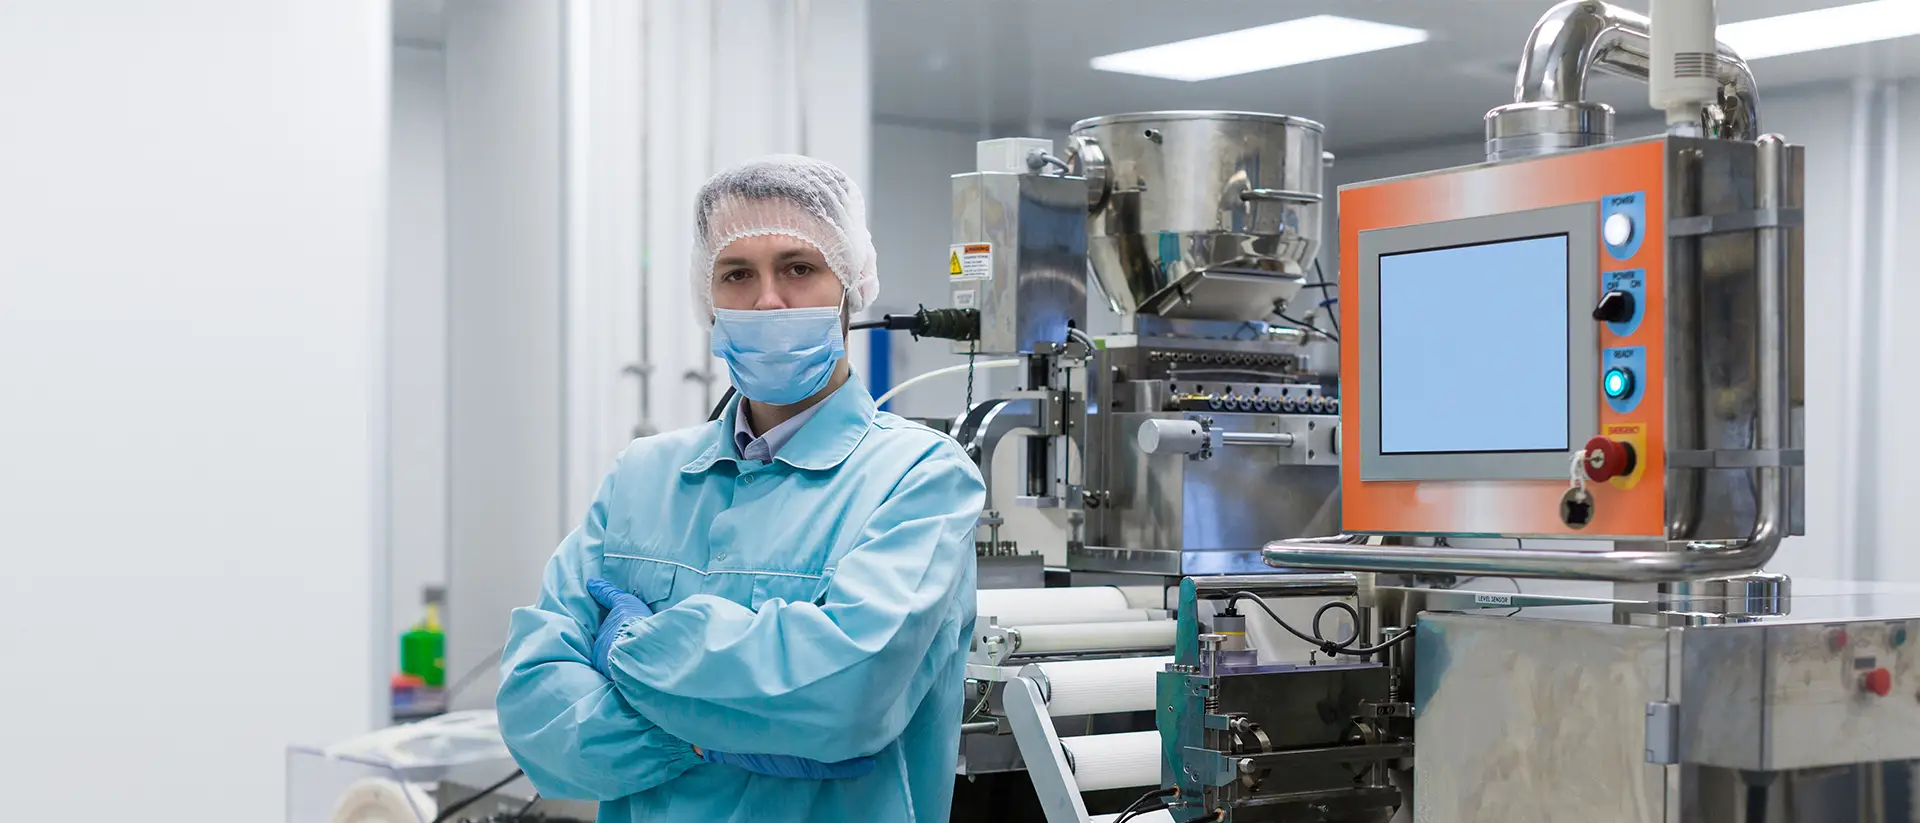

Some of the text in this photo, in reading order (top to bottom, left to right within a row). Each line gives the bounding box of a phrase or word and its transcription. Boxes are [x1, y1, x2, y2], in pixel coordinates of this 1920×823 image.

[1611, 196, 1636, 207] POWER
[1612, 272, 1635, 281] POWER
[1607, 280, 1641, 290] OFF ON
[1613, 349, 1634, 358] READY
[1607, 426, 1640, 435] EMERGENCY
